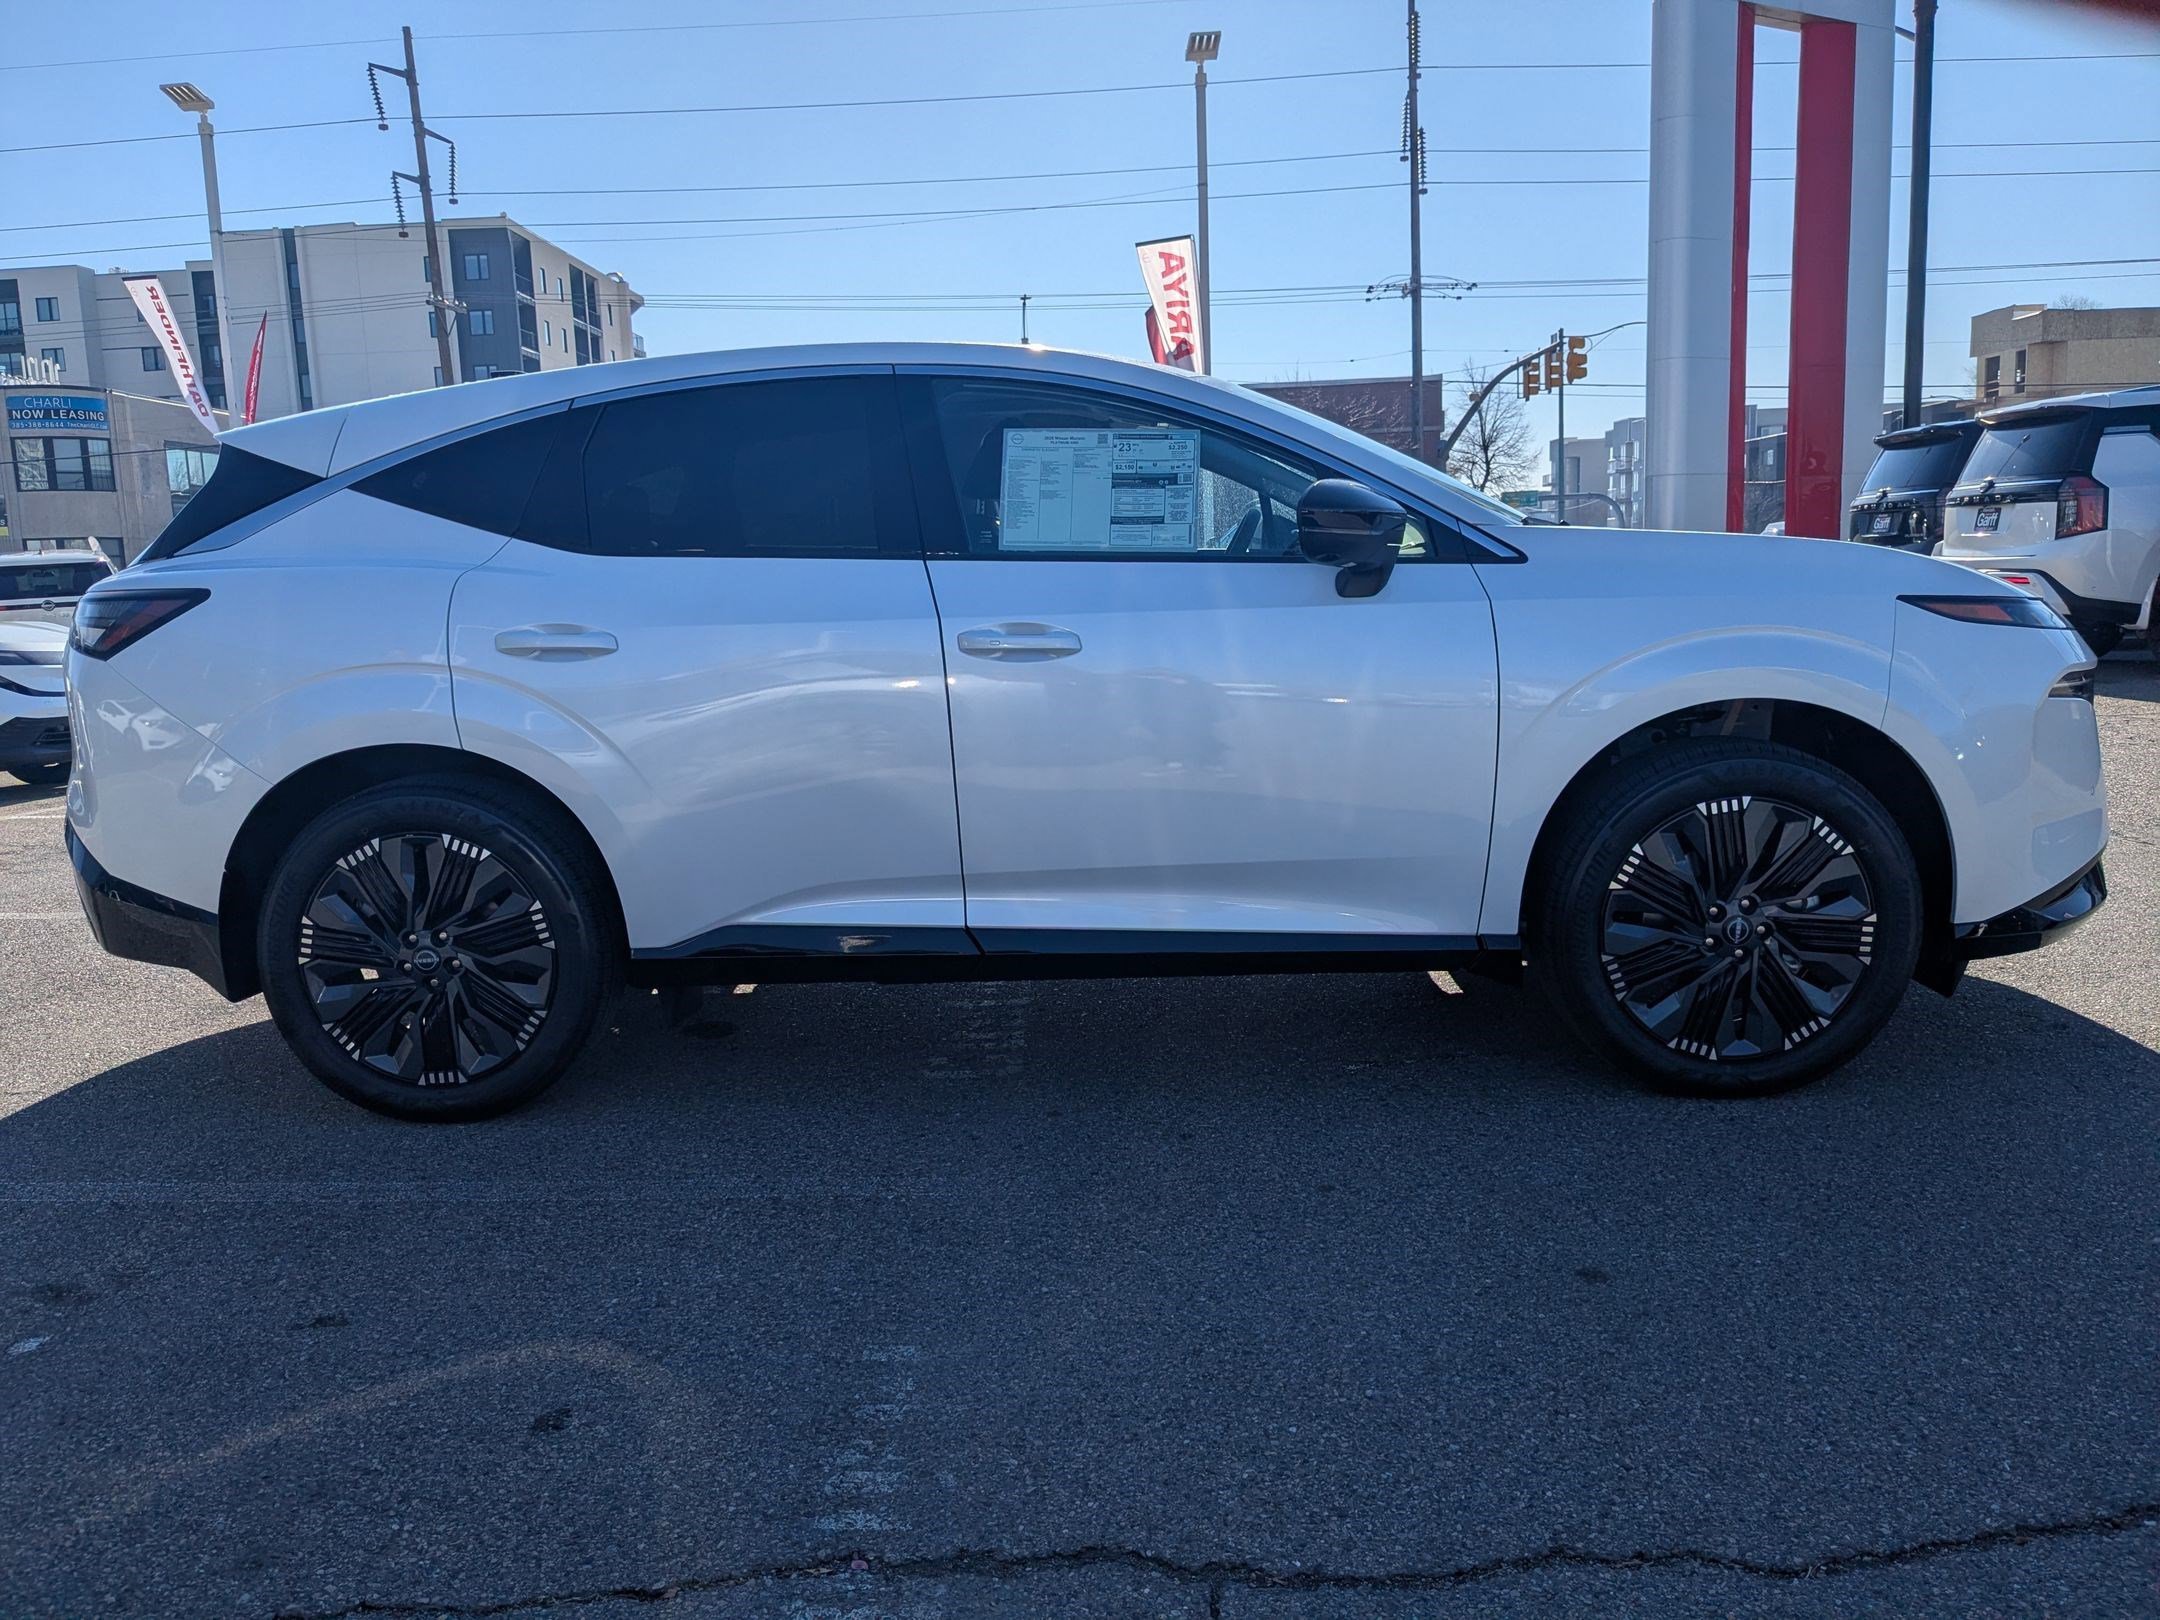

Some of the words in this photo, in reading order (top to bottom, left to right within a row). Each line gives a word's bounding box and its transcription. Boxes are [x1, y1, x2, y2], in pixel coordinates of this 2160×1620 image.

[24, 397, 72, 409] CHARLI
[12, 409, 44, 420] NOW
[51, 410, 105, 421] LEASING
[1119, 443, 1132, 452] 23
[1976, 512, 1998, 527] Garff
